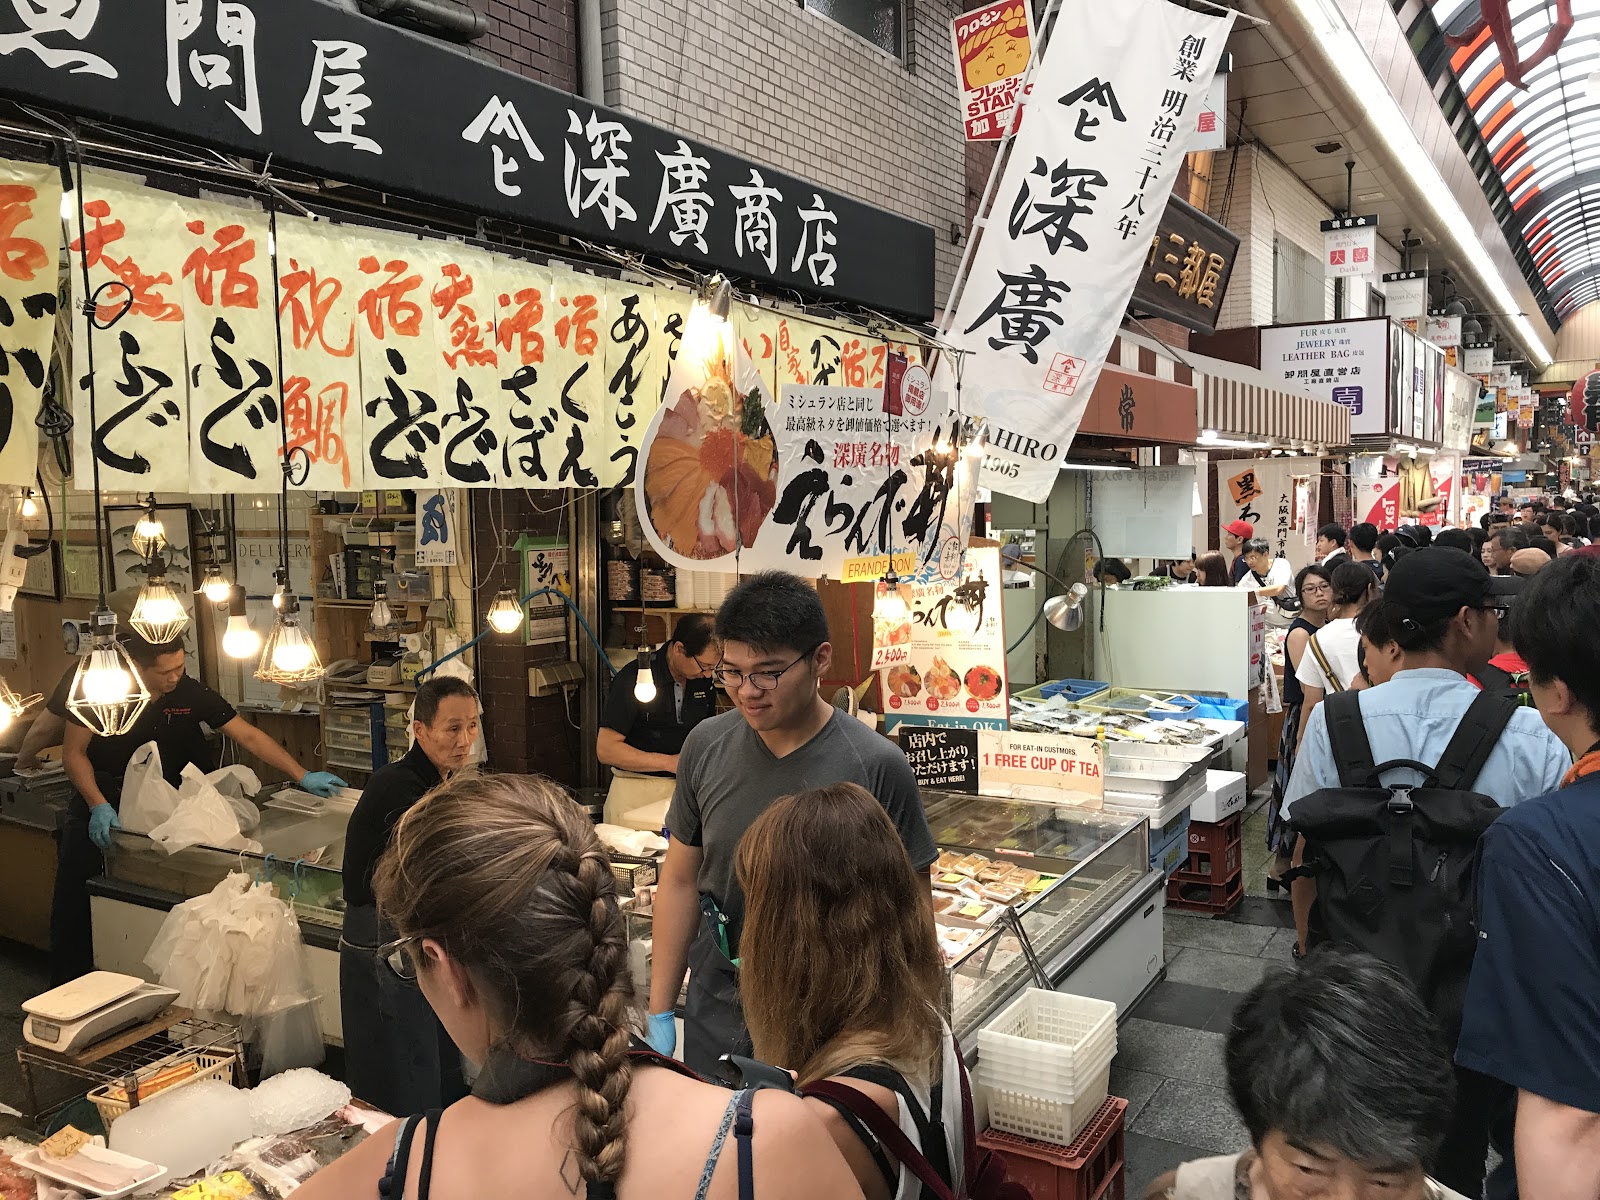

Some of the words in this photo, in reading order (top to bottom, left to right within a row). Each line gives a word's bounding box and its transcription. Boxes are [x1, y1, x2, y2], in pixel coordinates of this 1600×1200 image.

[958, 10, 1001, 40] クロモン
[1171, 33, 1207, 83] 創業
[1113, 88, 1188, 241] 明治三十八年
[562, 108, 837, 288] 深廣商店
[963, 155, 1109, 366] 深廣
[1295, 339, 1336, 350] JEWELRY
[1300, 328, 1318, 337] FUR
[1282, 351, 1326, 362] LEATHER
[1330, 349, 1350, 358] BAG
[278, 257, 356, 489] 祝鯛
[608, 294, 651, 490] あんこう
[788, 394, 875, 413] ミシュラン店と同じ
[833, 441, 901, 469] 深廣名物
[982, 454, 1021, 479] 1905
[909, 732, 947, 749] 店内で
[905, 745, 969, 763] お召し上がり
[983, 753, 989, 766] 1
[995, 753, 1027, 769] FREE
[1031, 756, 1057, 771] CUP
[1061, 759, 1076, 773] OF
[1079, 761, 1100, 778] TEA
[917, 778, 930, 786] BUY
[930, 777, 936, 785] &
[936, 776, 947, 784] EAT
